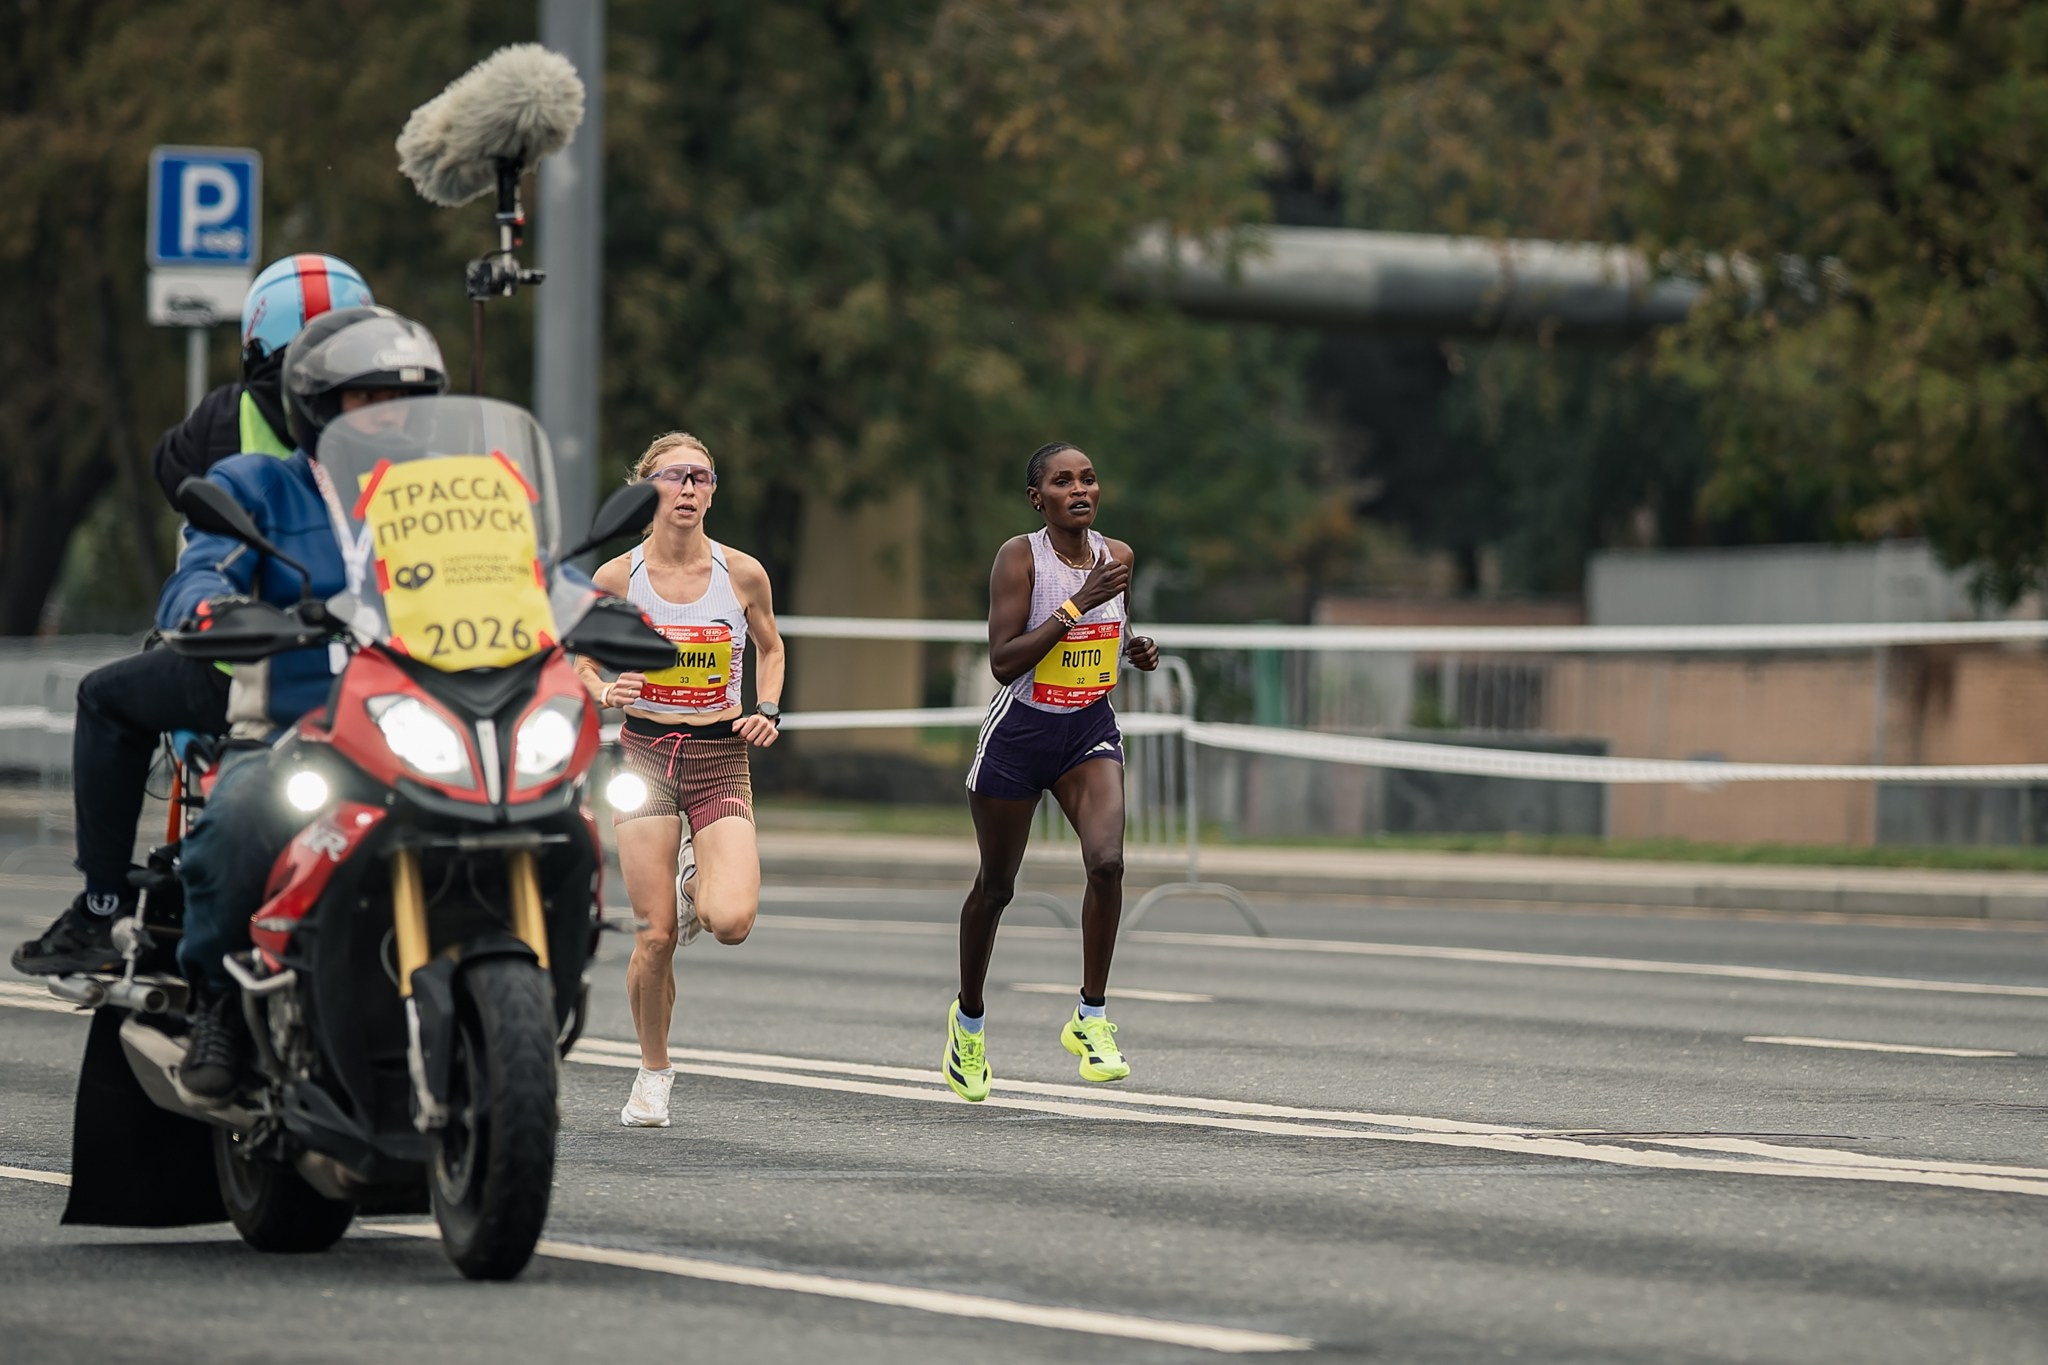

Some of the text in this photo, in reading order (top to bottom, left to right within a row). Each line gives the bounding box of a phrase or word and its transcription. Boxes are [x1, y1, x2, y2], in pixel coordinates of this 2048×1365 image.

[180, 165, 240, 254] P
[384, 477, 509, 510] ТРАССА
[378, 508, 527, 546] ПРОПУСК
[424, 617, 531, 658] 2026
[676, 652, 716, 668] КИНА
[1062, 649, 1101, 667] RUTTO
